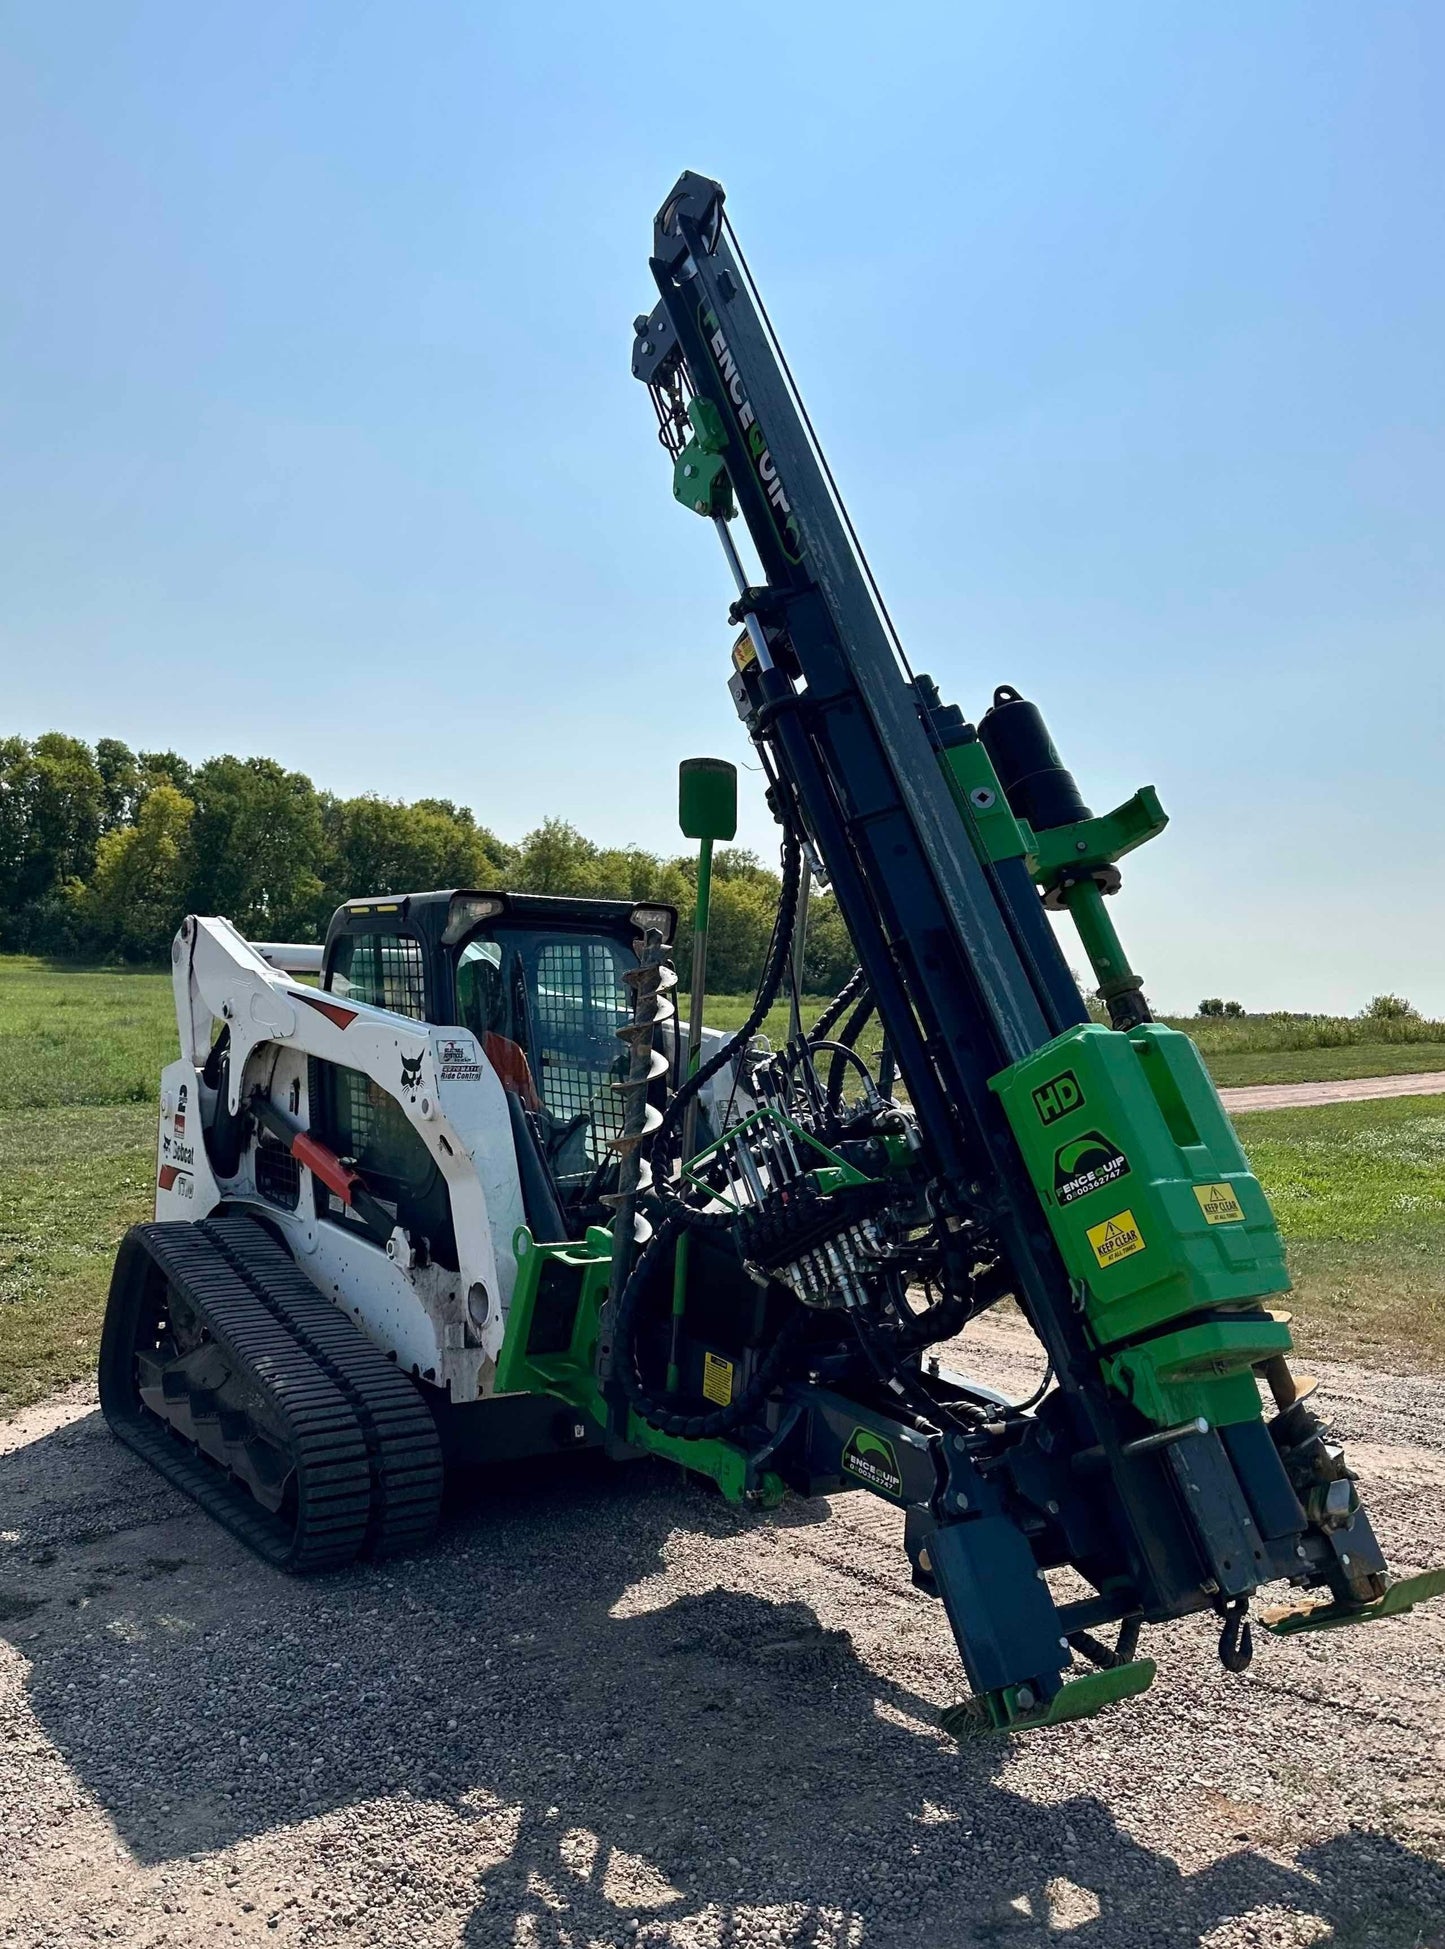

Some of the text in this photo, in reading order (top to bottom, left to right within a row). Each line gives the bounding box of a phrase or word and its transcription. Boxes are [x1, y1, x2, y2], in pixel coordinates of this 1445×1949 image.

[441, 1072, 481, 1080] Ride Control
[1035, 1078, 1078, 1120] HD
[173, 1140, 194, 1165] Bobcat
[1056, 1155, 1125, 1198] FENCEQUIP
[1203, 1200, 1239, 1213] KEEP CLEAR
[1097, 1229, 1138, 1256] KEEP CLEAR
[844, 1452, 899, 1485] FENCEQUIP
